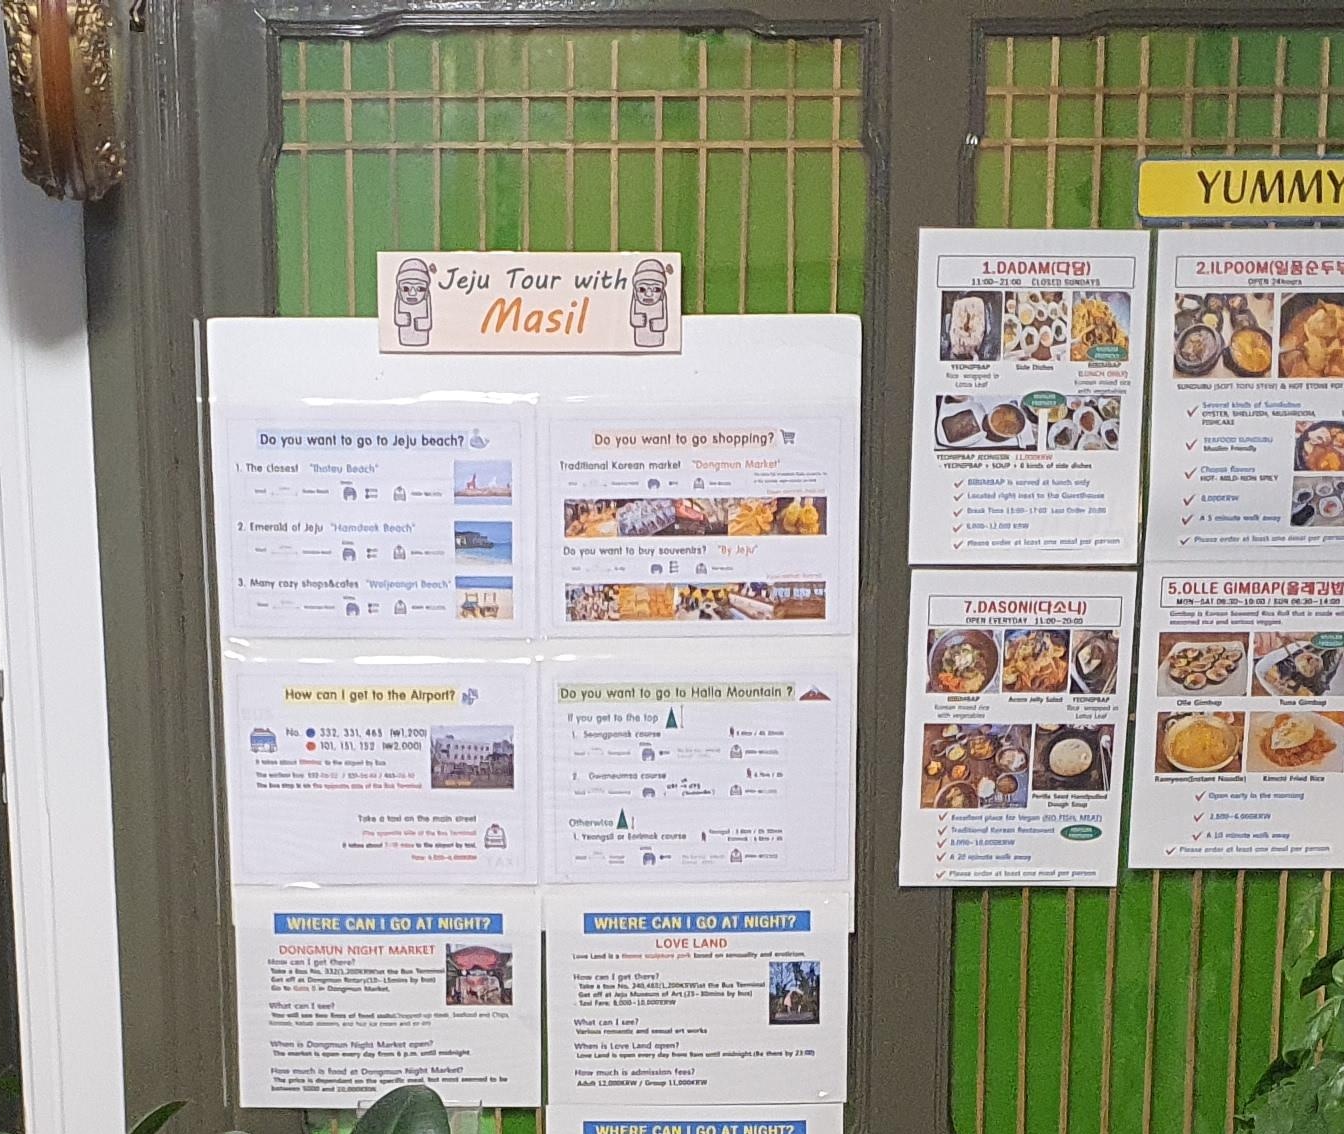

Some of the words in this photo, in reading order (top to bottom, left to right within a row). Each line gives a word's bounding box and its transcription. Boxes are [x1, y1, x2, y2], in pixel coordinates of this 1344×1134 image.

[982, 261, 1091, 276] 1.DADAM(다담)
[438, 268, 490, 294] Jeju
[506, 268, 561, 289] Tour
[574, 268, 627, 290] with
[480, 297, 590, 335] Masil
[260, 434, 276, 446] Do
[282, 436, 301, 448] you
[307, 435, 336, 446] want
[341, 435, 352, 446] to
[357, 437, 372, 448] go
[376, 435, 388, 446] to
[392, 434, 417, 449] Jeju
[422, 434, 464, 447] beach?
[594, 434, 610, 445] Do
[616, 436, 636, 448] you
[642, 434, 671, 445] want
[676, 434, 687, 445] to
[692, 436, 707, 447] go
[713, 432, 774, 447] shopping?
[246, 463, 262, 473] The
[267, 463, 298, 473] closest
[560, 460, 608, 471] Traditional
[612, 460, 644, 470] Korean
[649, 460, 681, 470] market
[250, 522, 288, 532] Emerald
[292, 522, 301, 532] of
[305, 522, 324, 533] Jeju
[563, 546, 578, 556] Do
[580, 548, 596, 556] you
[599, 546, 622, 556] want
[626, 546, 635, 556] to
[639, 546, 654, 557] buy
[250, 579, 275, 589] Many
[1168, 581, 1218, 595] 5.OLLE
[965, 600, 1086, 615] 7.DASONI(다소니)
[285, 689, 312, 700] How
[316, 691, 337, 700] can
[350, 690, 368, 703] get
[373, 689, 383, 700] to
[388, 689, 406, 700] the
[410, 689, 455, 704] Airport?
[560, 688, 576, 699] Do
[582, 690, 601, 701] you
[607, 688, 636, 699] want
[640, 688, 650, 699] to
[656, 690, 670, 701] go
[676, 688, 686, 699] to
[691, 687, 722, 698] Halla
[727, 686, 782, 697] Mountain
[576, 715, 592, 724] you
[596, 714, 610, 724] get
[614, 714, 623, 722] to
[626, 714, 640, 722] the
[644, 714, 658, 723] top
[358, 815, 377, 823] Take
[418, 815, 430, 823] the
[432, 815, 452, 823] main
[287, 917, 340, 930] WHERE
[346, 917, 375, 930] CAN
[391, 917, 410, 930] GO
[416, 917, 432, 930] AT
[438, 917, 491, 930] NIGHT?
[594, 916, 646, 930] WHERE
[652, 916, 681, 930] CAN
[697, 916, 716, 930] GO
[722, 916, 738, 930] AT
[744, 916, 797, 930] NIGHT?
[279, 945, 343, 955] DONGMUN
[347, 945, 383, 955] NIGHT
[388, 945, 436, 955] MARKET
[656, 938, 688, 949] LOVE
[693, 938, 728, 949] LAND
